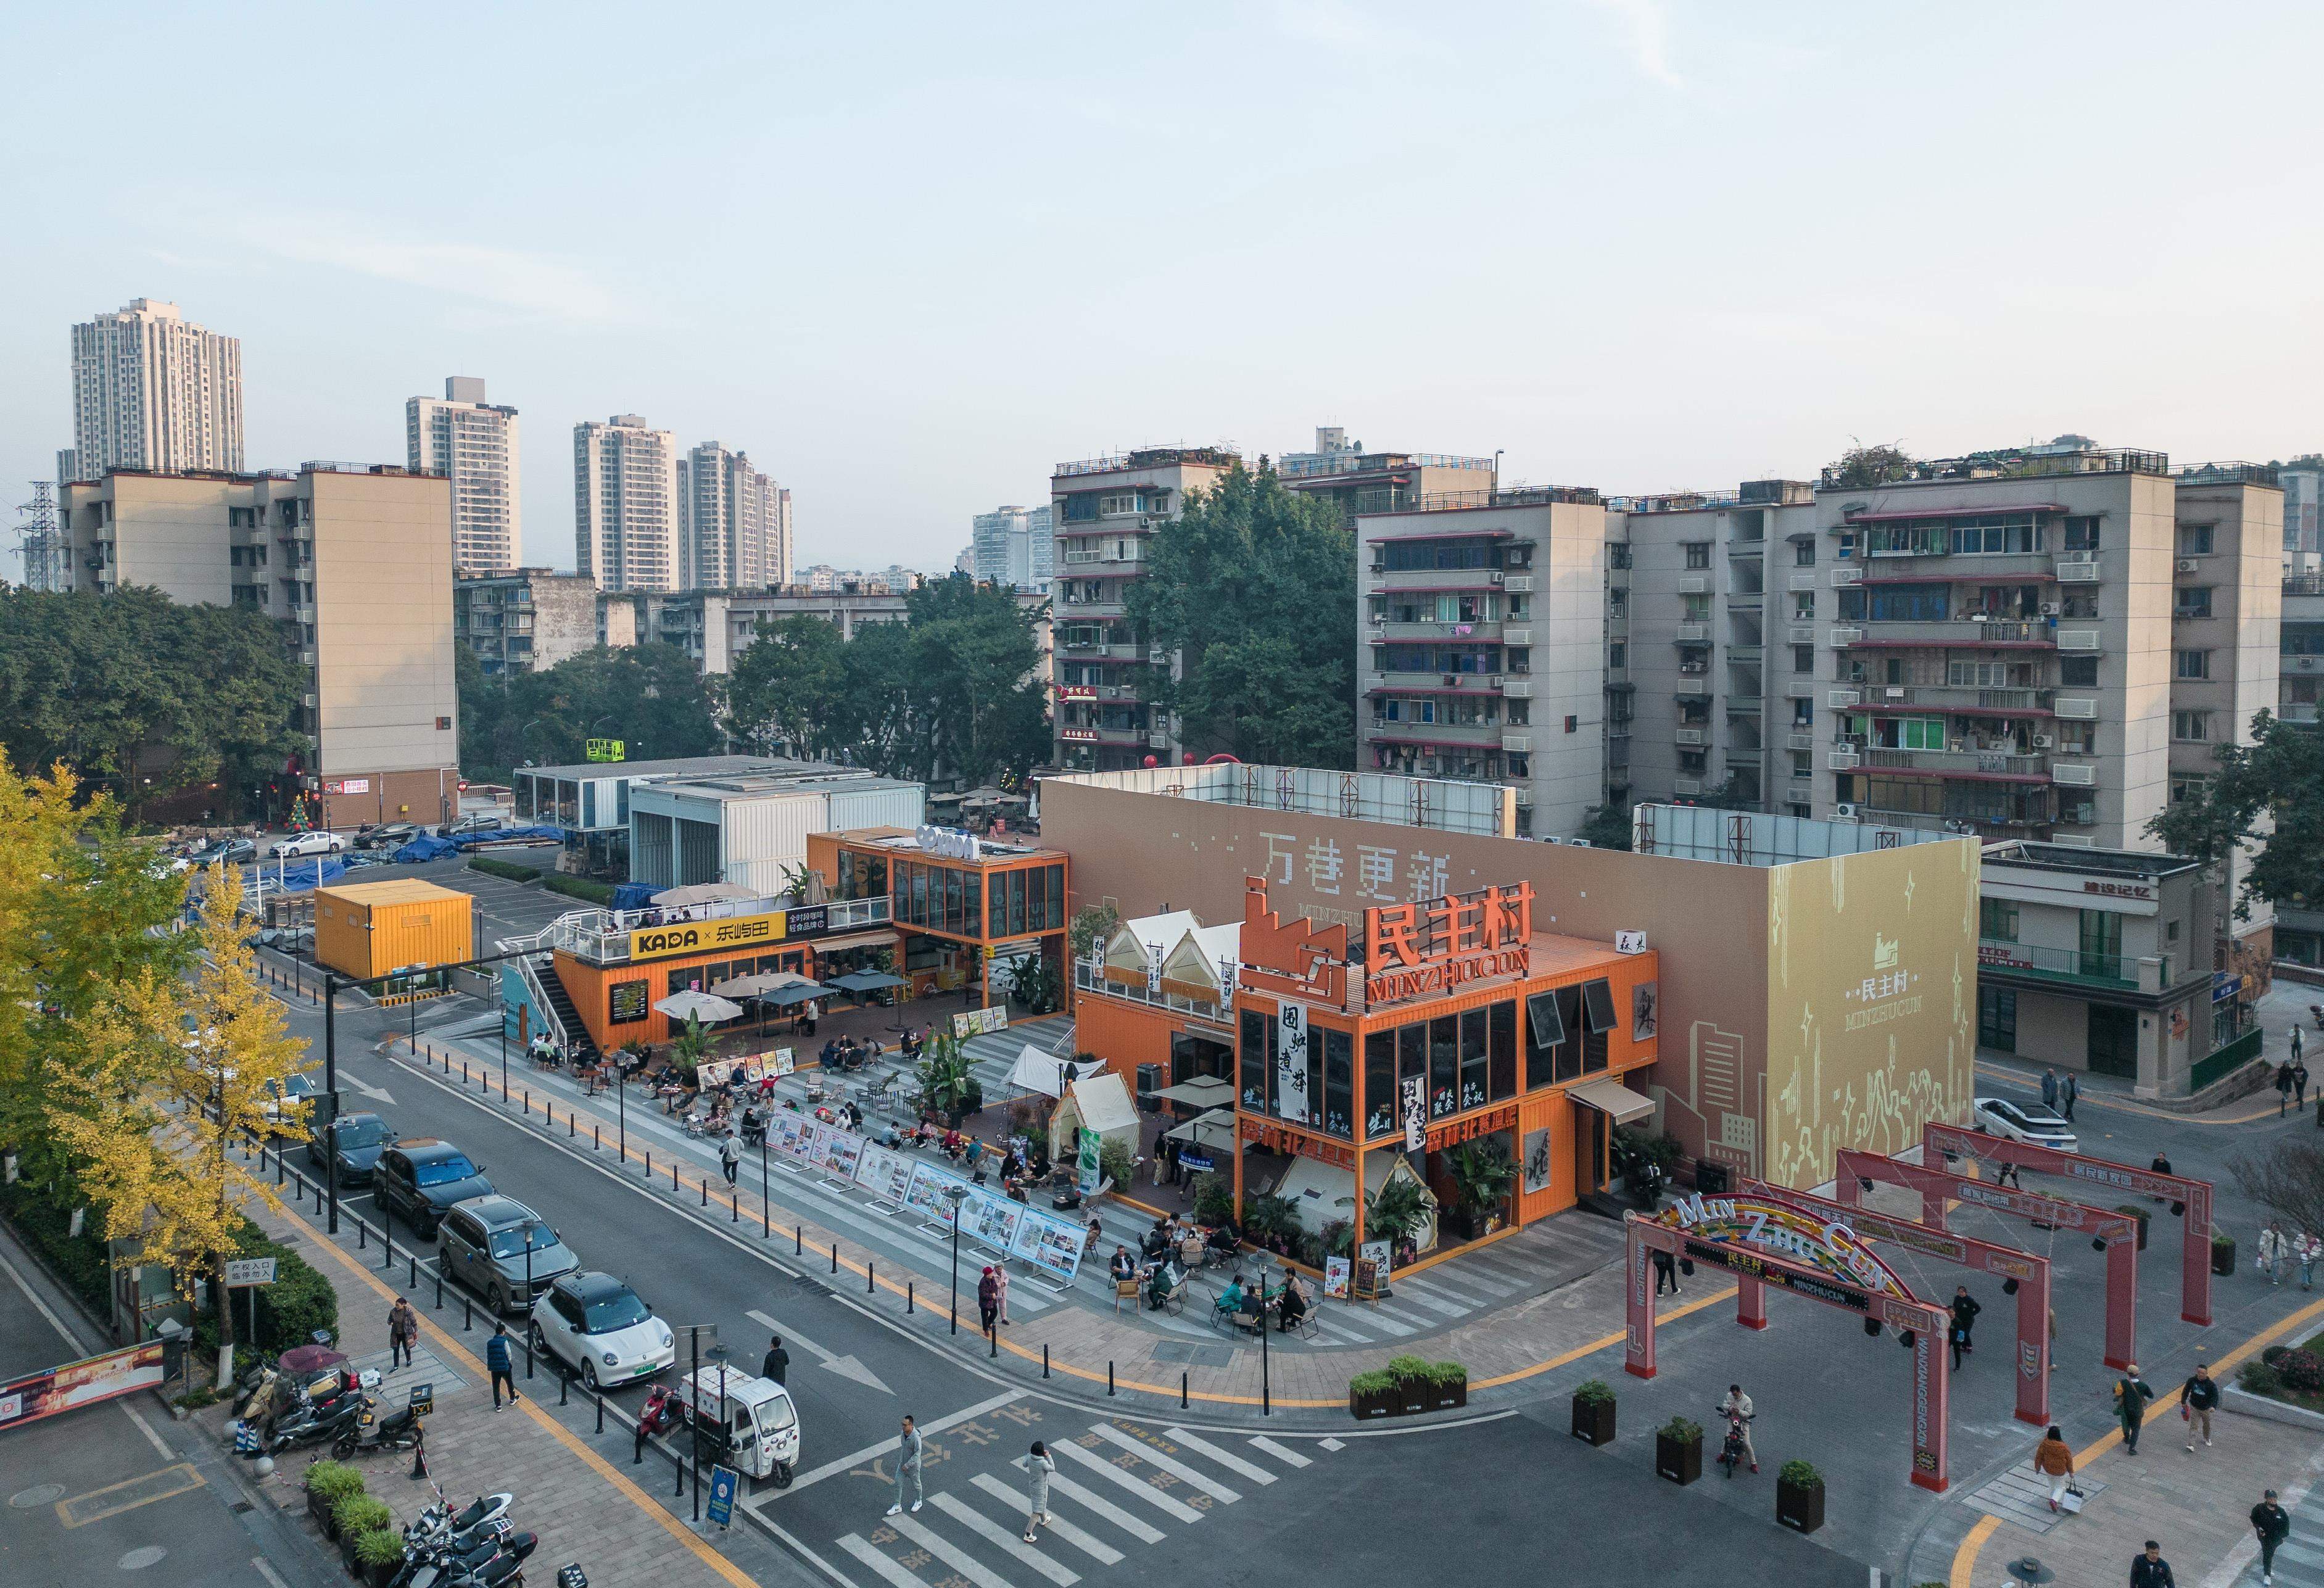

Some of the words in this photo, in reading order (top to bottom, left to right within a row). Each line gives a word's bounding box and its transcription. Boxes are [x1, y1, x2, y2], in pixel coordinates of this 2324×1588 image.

[1259, 831, 1450, 909] 万巷更新
[2083, 881, 2151, 898] 建设记忆
[1363, 880, 1536, 975] 民主村
[639, 930, 698, 953] KADA
[1366, 947, 1530, 1004] MINZHUCUN
[1861, 969, 1908, 1003] 民主村
[1845, 995, 1923, 1032] MINZHUCUN
[1278, 1005, 1307, 1093] 围炉煮茶
[2075, 1164, 2132, 1186] 居民新家园
[231, 1261, 270, 1272] 产权入口
[1728, 1252, 1761, 1270] 民主村
[231, 1268, 271, 1280] 临停勿入
[1637, 1241, 1645, 1307] MINZHUCUN
[1793, 1279, 1846, 1302] MINZHUCUN
[1888, 1305, 1924, 1323] SPACE
